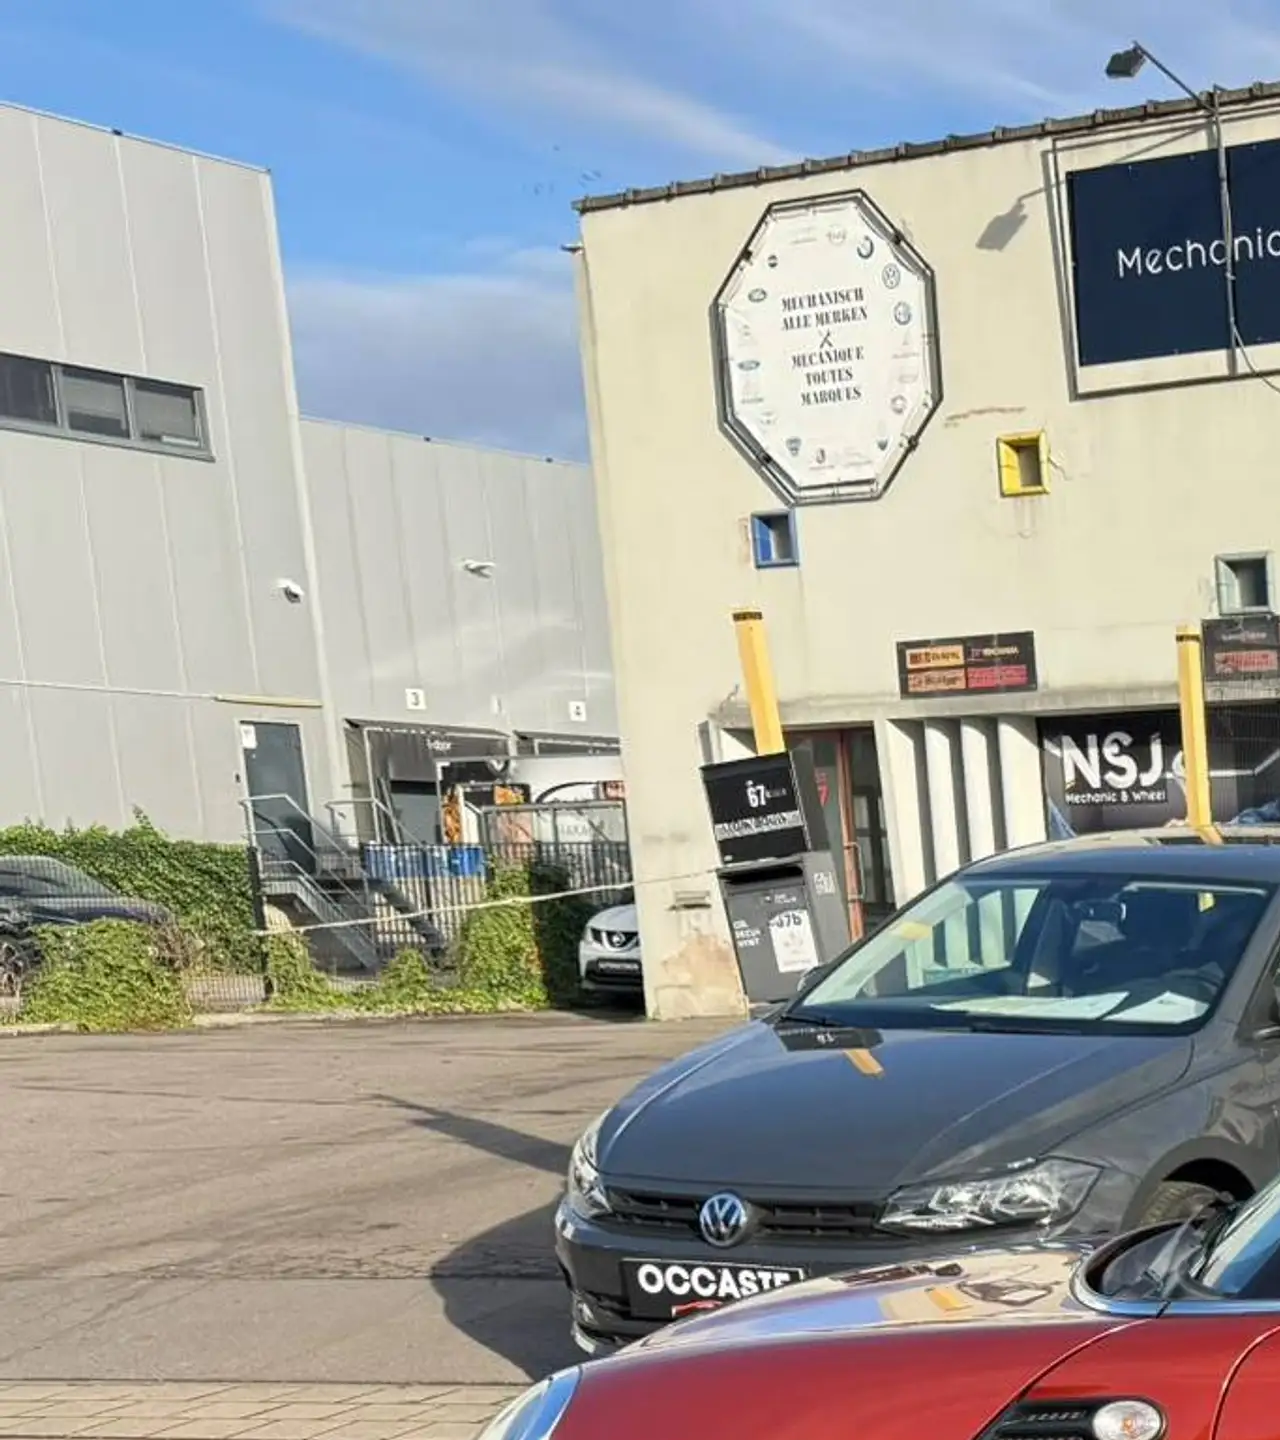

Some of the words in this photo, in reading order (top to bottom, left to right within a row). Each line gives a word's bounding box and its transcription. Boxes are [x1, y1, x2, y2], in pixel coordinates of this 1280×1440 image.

[781, 286, 864, 312] MECHANISCH
[781, 314, 812, 331] ALLE
[815, 305, 868, 328] MERKEN
[805, 366, 854, 386] TOUTES
[800, 386, 862, 406] MARQUES
[1061, 731, 1163, 790] NSJ
[1065, 791, 1117, 804] Mechanic
